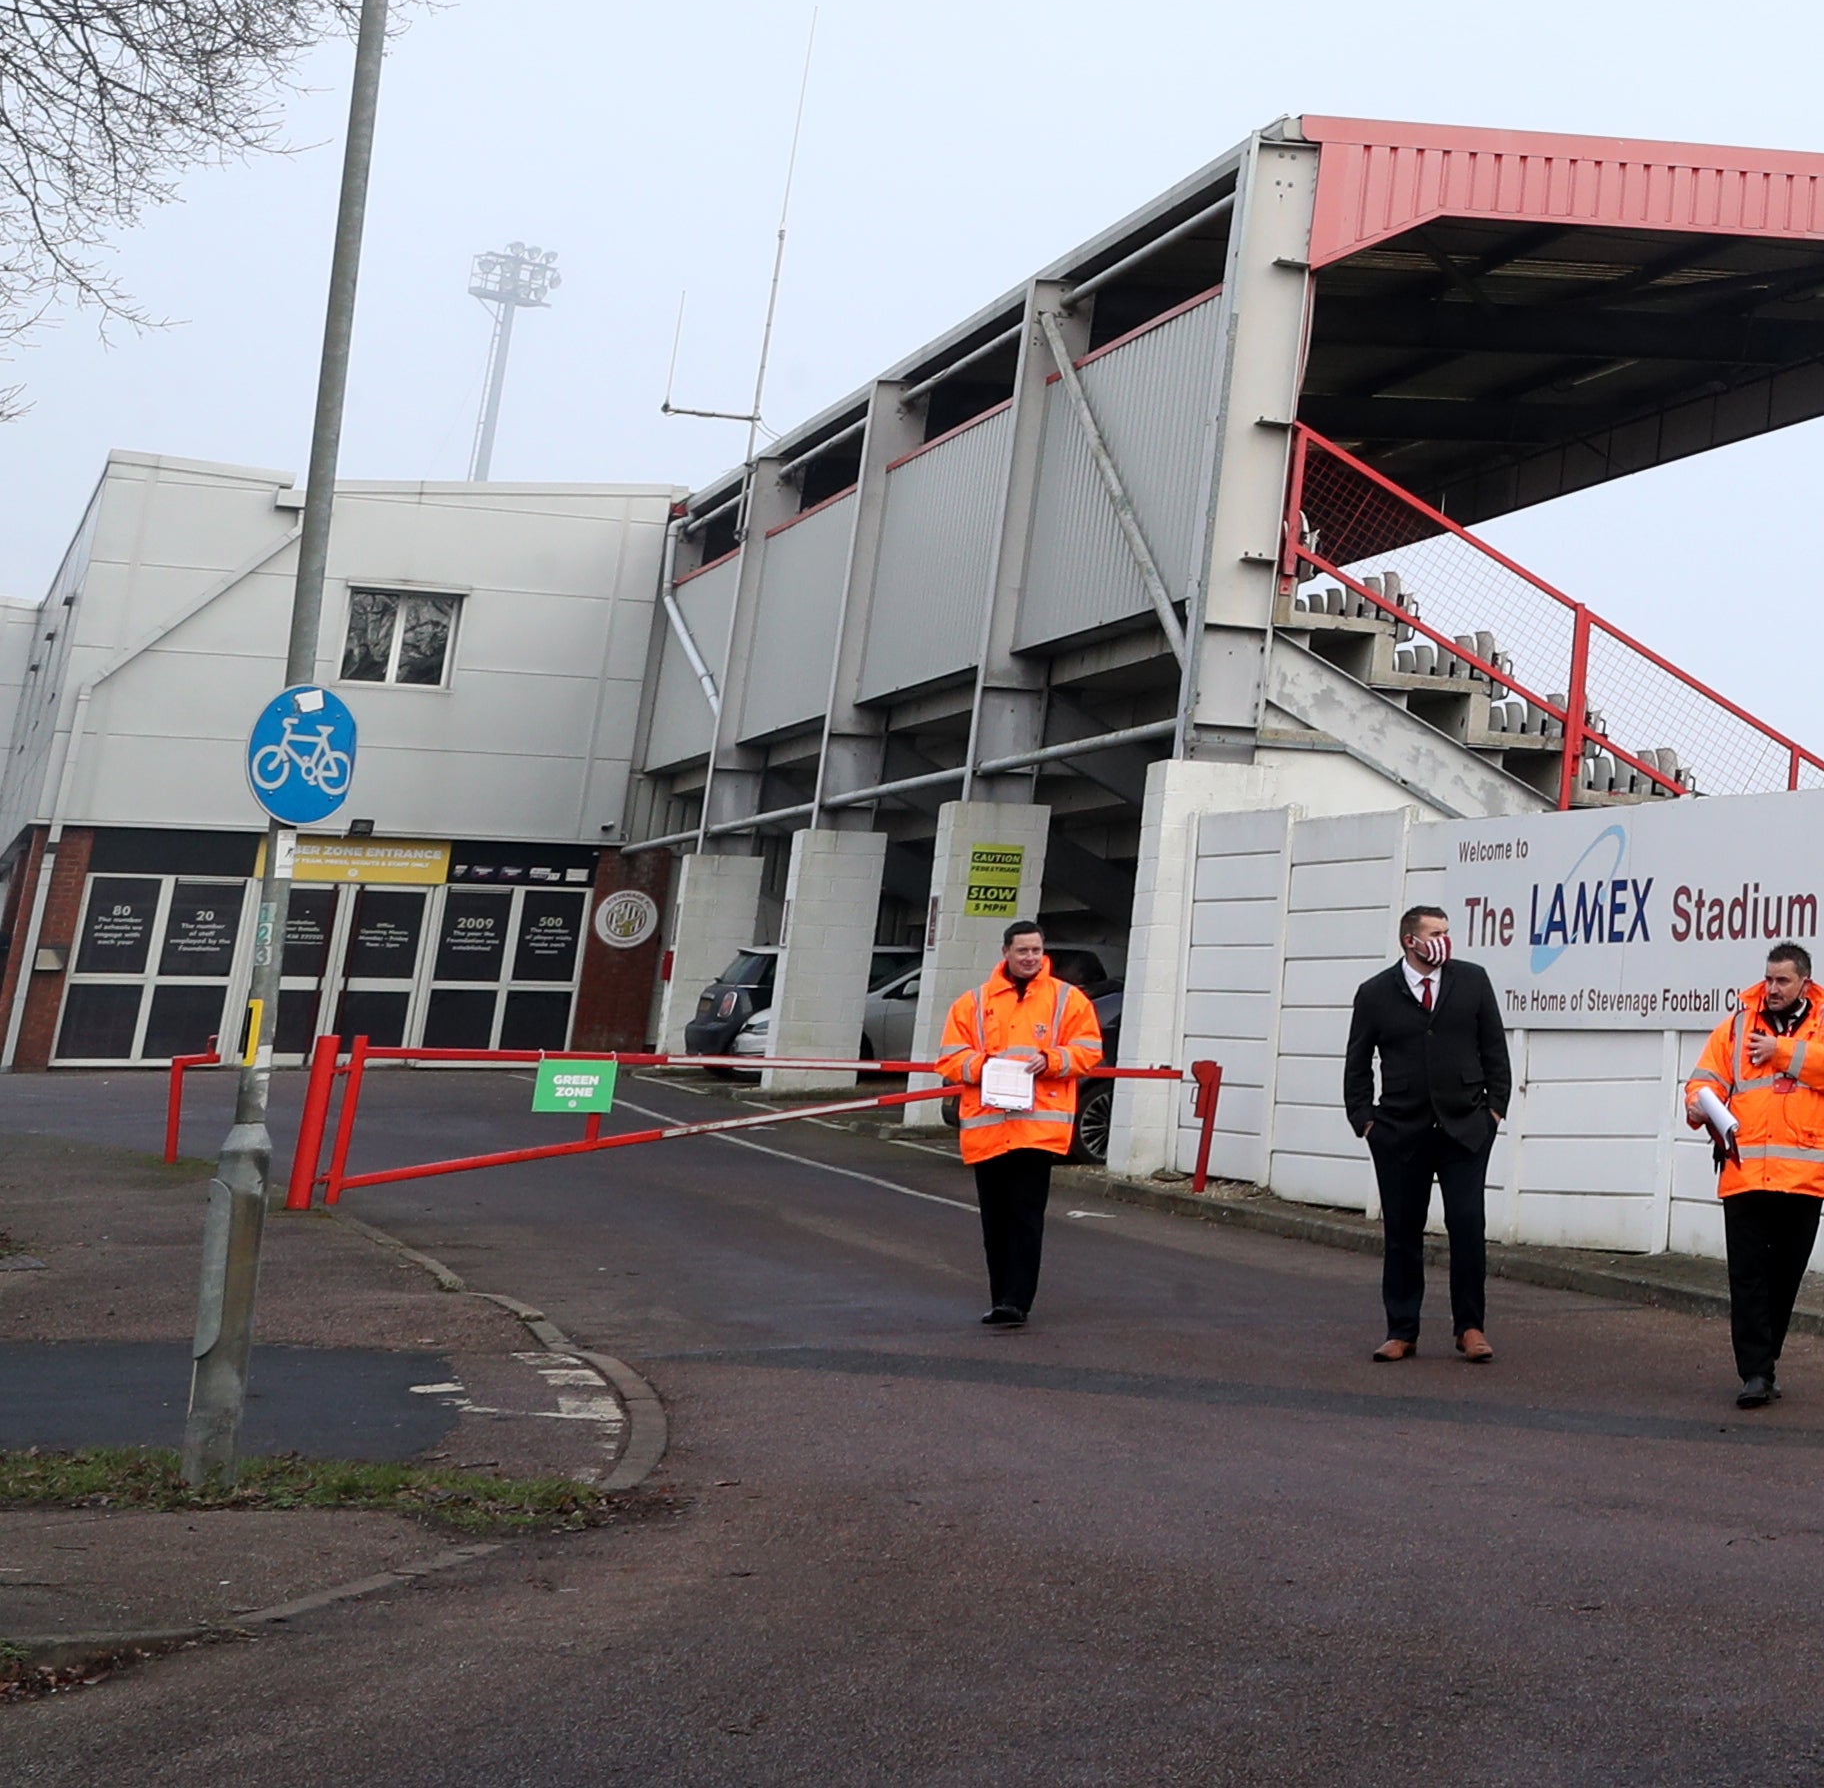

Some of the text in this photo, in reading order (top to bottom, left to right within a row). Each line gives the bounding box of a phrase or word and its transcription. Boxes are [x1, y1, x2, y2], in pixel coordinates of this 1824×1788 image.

[323, 845, 363, 857] ZONE
[365, 847, 442, 860] ENTRANCE
[1458, 838, 1529, 863] Welcome to
[973, 853, 1021, 863] CAUTION
[971, 865, 1020, 873] PEDESTRIANS
[969, 887, 1016, 900] SLOW
[112, 905, 131, 916] 80
[974, 903, 1007, 912] 5 MPH
[1465, 877, 1819, 948] The LAMEX Stadium
[195, 911, 214, 921] 20
[457, 917, 494, 929] 2009
[538, 917, 563, 927] 500
[1504, 990, 1527, 1012] The
[1530, 989, 1568, 1012] Home
[1570, 988, 1585, 1012] of
[1587, 989, 1658, 1018] Stevenage
[1662, 987, 1720, 1012] Football
[553, 1074, 600, 1085] GREEN
[554, 1086, 594, 1097] ZONE
